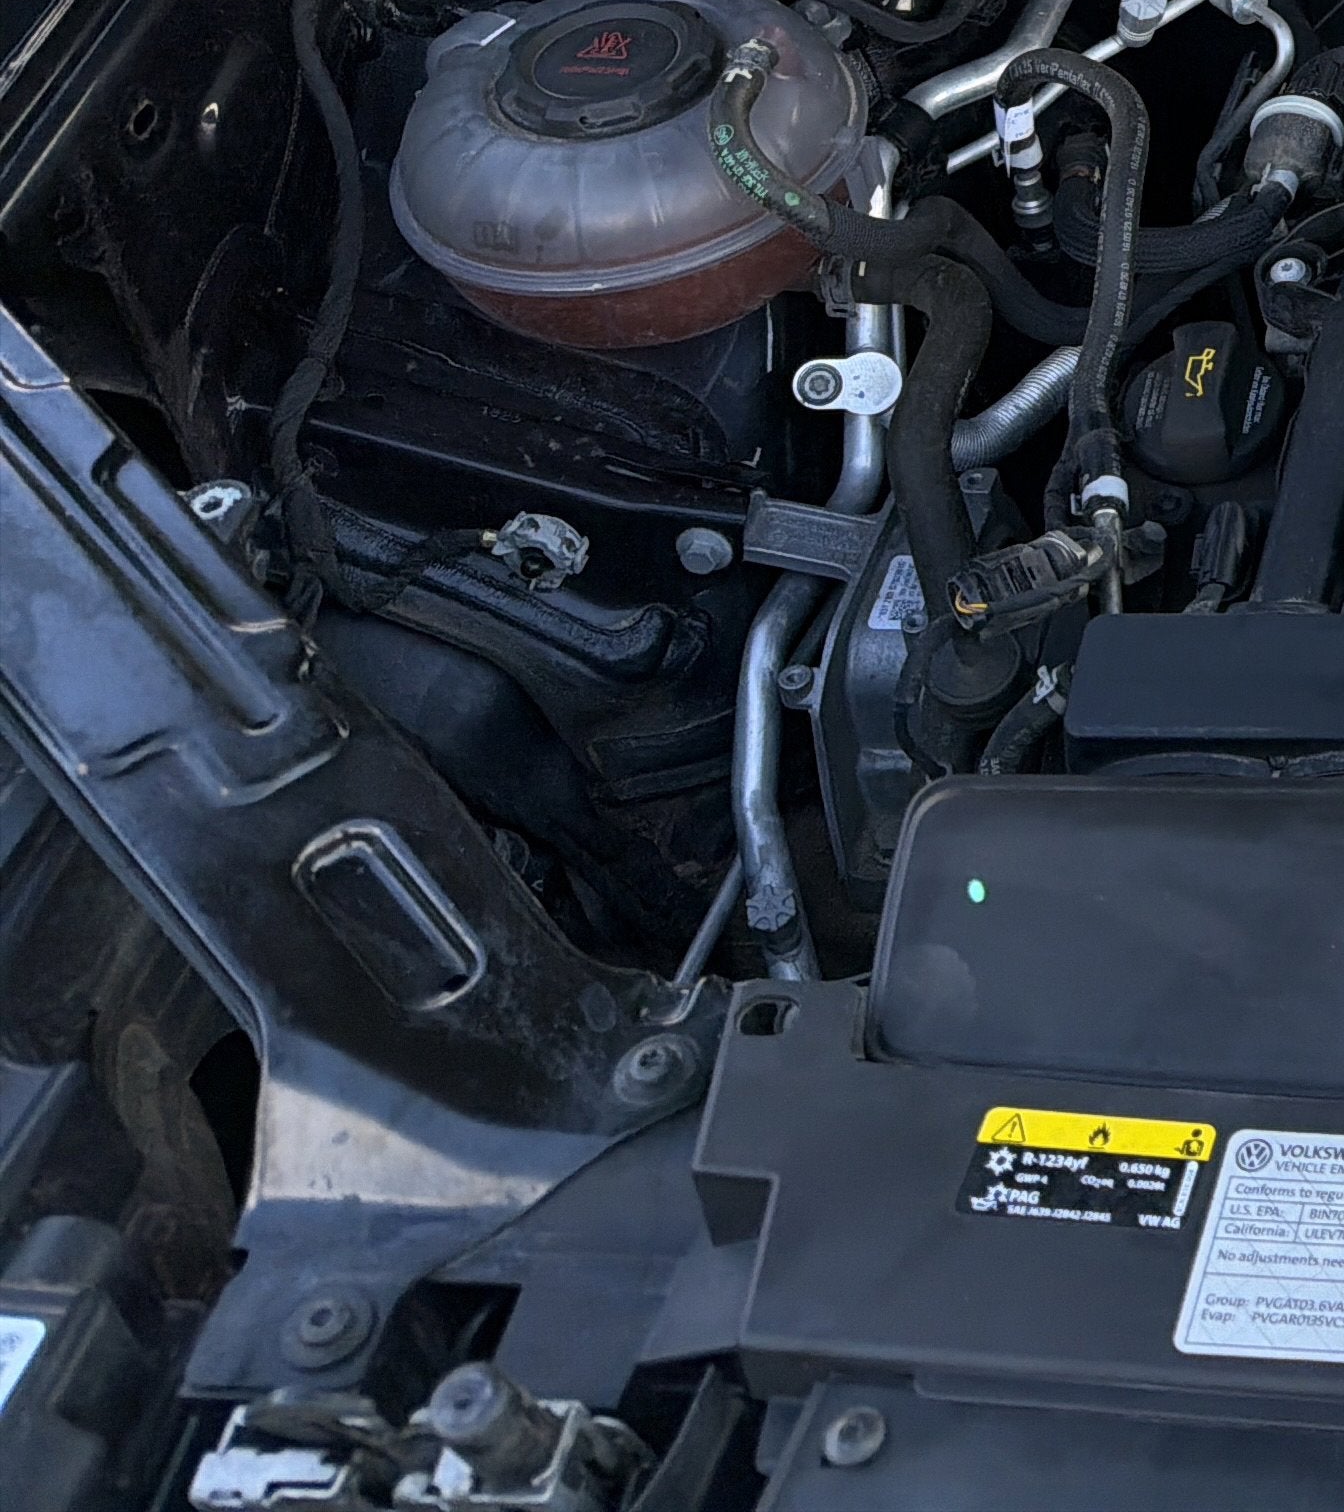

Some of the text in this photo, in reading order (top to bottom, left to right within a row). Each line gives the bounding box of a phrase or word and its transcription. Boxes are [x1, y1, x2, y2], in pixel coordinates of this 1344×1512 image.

[1021, 1151, 1171, 1179] R-1234yf 0.650 kg
[1275, 1160, 1326, 1175] VEHICLE
[1008, 1188, 1040, 1206] PAG
[1235, 1182, 1295, 1197] Conforms
[1300, 1187, 1312, 1198] to
[1229, 1204, 1253, 1216] U.S.
[1257, 1204, 1284, 1218] EPA:
[1137, 1213, 1181, 1229] VW AG
[1224, 1222, 1289, 1237] California:
[1217, 1249, 1236, 1261] No
[1239, 1250, 1319, 1266] adjustments
[1205, 1293, 1249, 1308] Group:
[1200, 1308, 1235, 1323] Evap:
